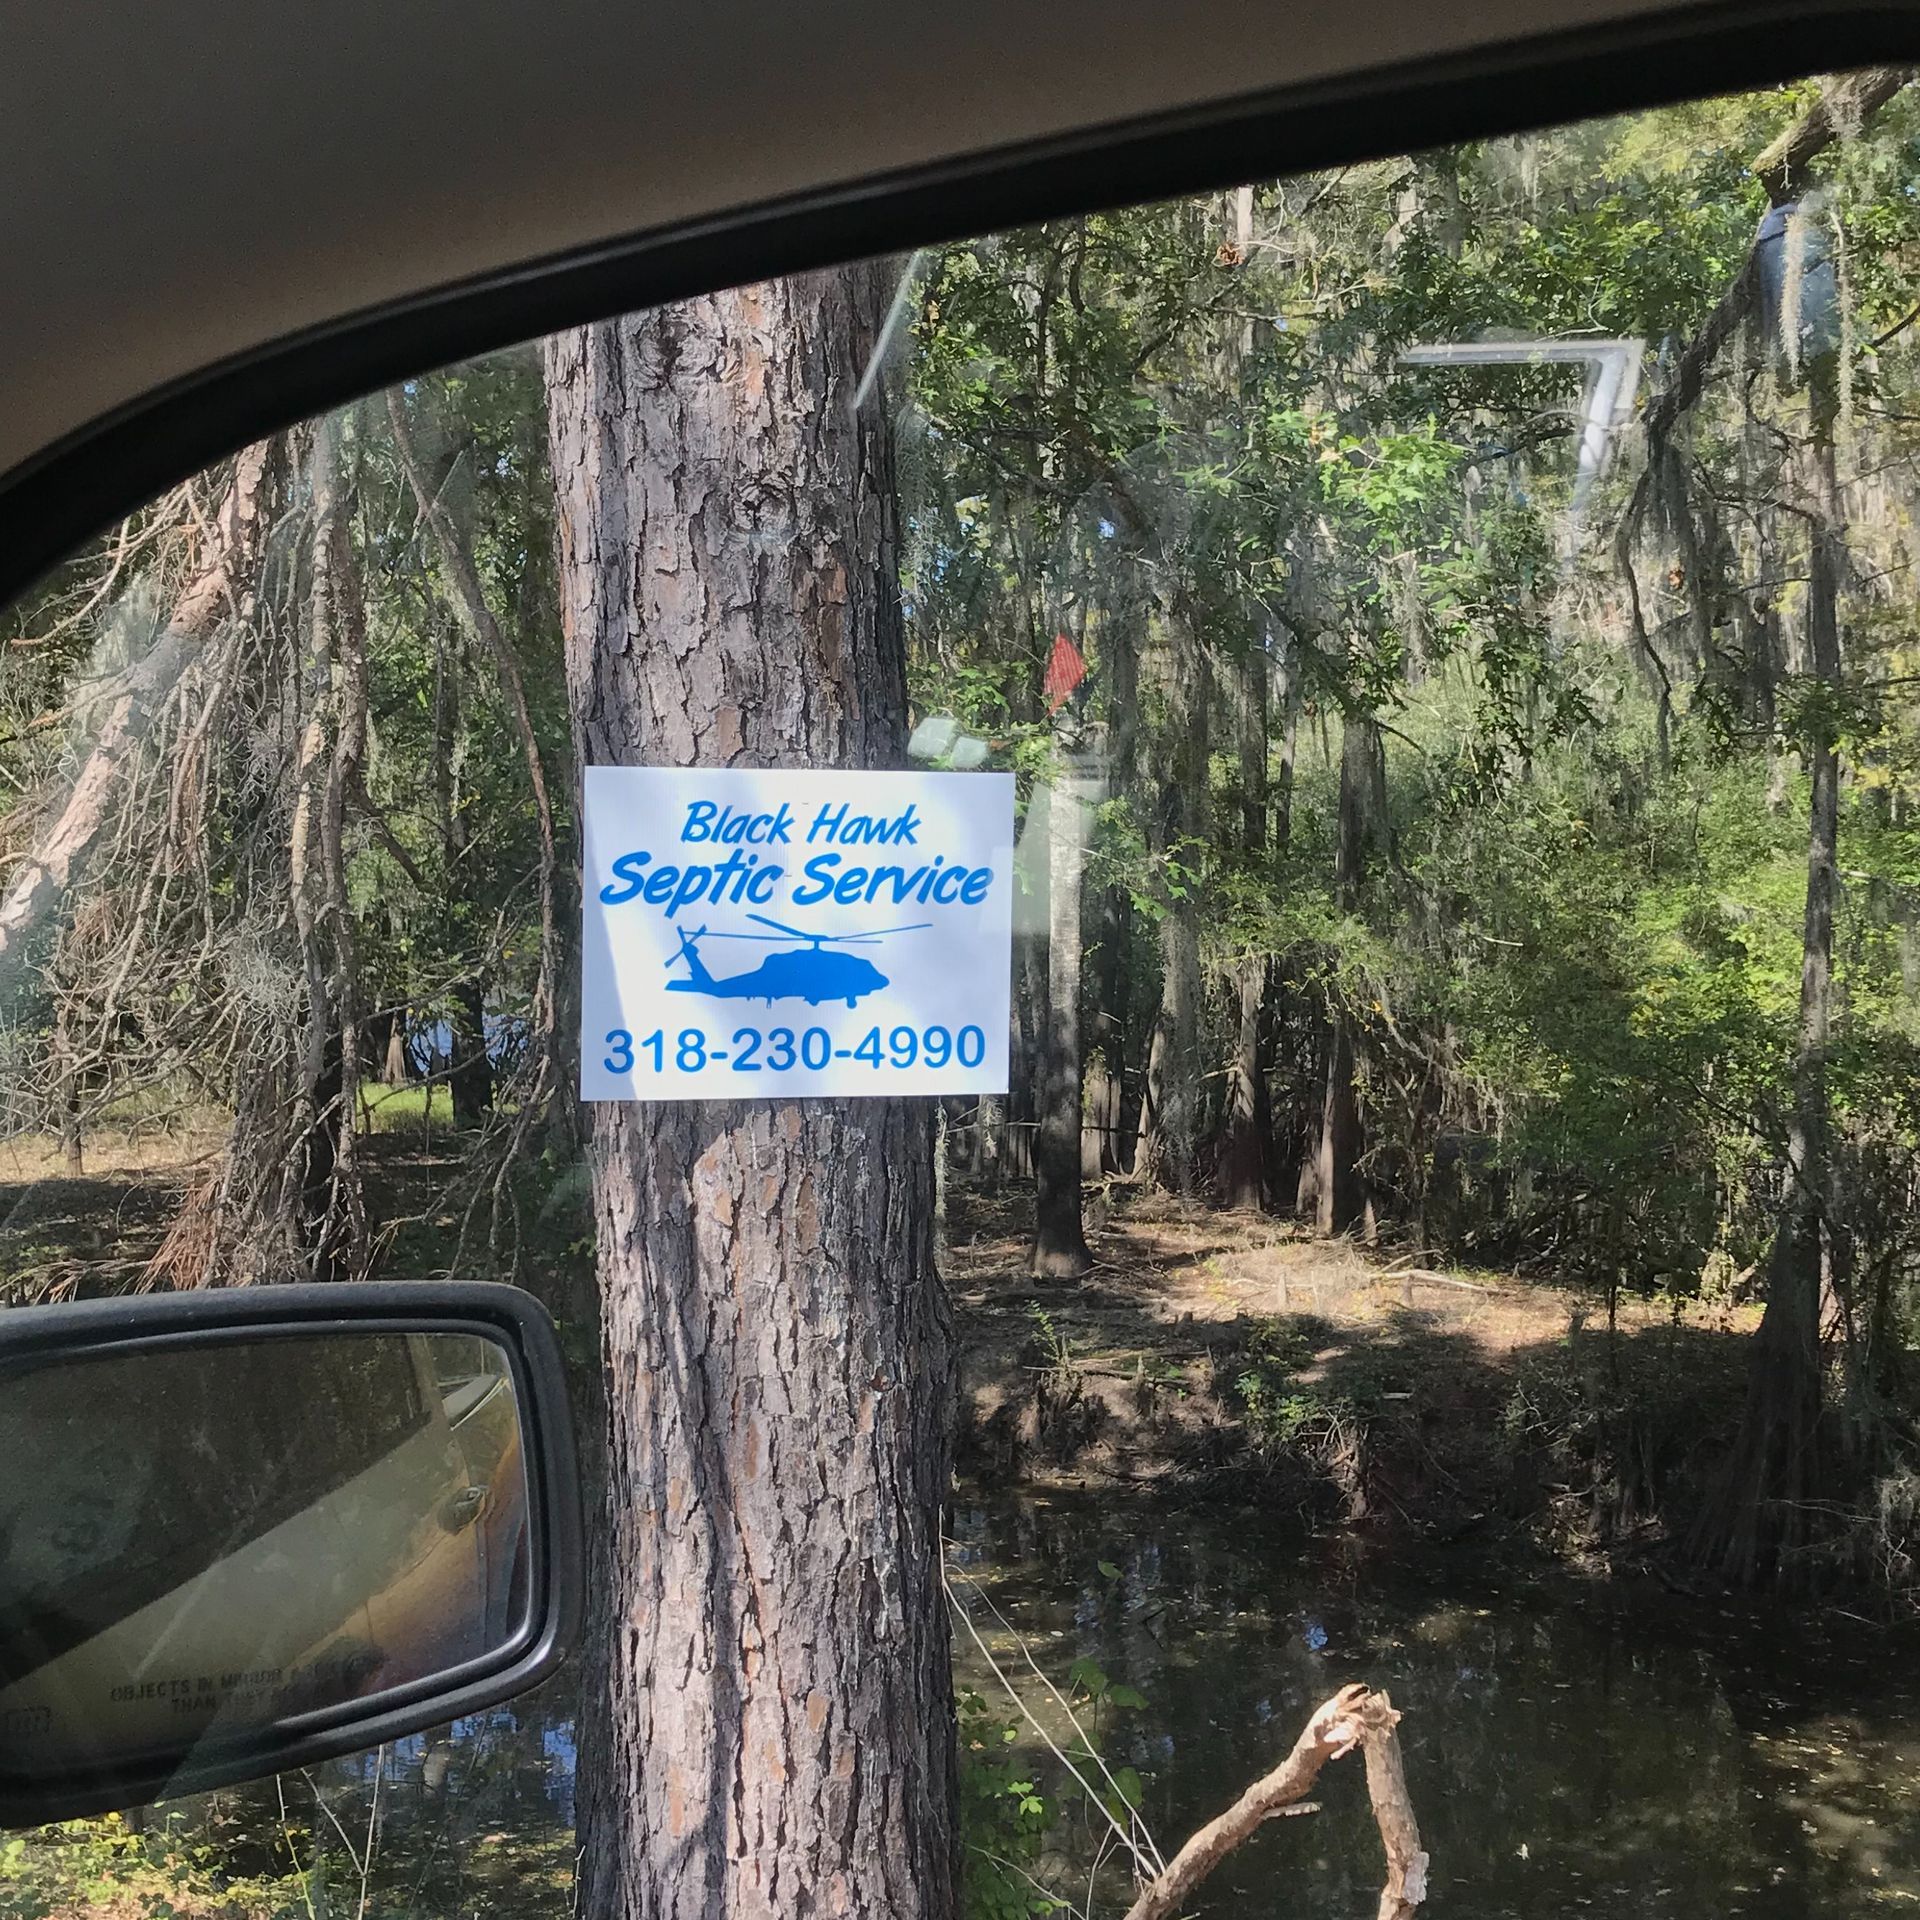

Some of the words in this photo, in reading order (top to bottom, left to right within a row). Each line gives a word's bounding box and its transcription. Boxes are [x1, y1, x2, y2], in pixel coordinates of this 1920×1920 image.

[680, 800, 795, 844] Black
[806, 803, 921, 844] Hawk
[600, 848, 783, 918] Septic
[792, 853, 994, 905] Service
[603, 1025, 986, 1074] 318-230-4990
[110, 1680, 190, 1701] OBJECTS
[171, 1695, 218, 1713] THAN
